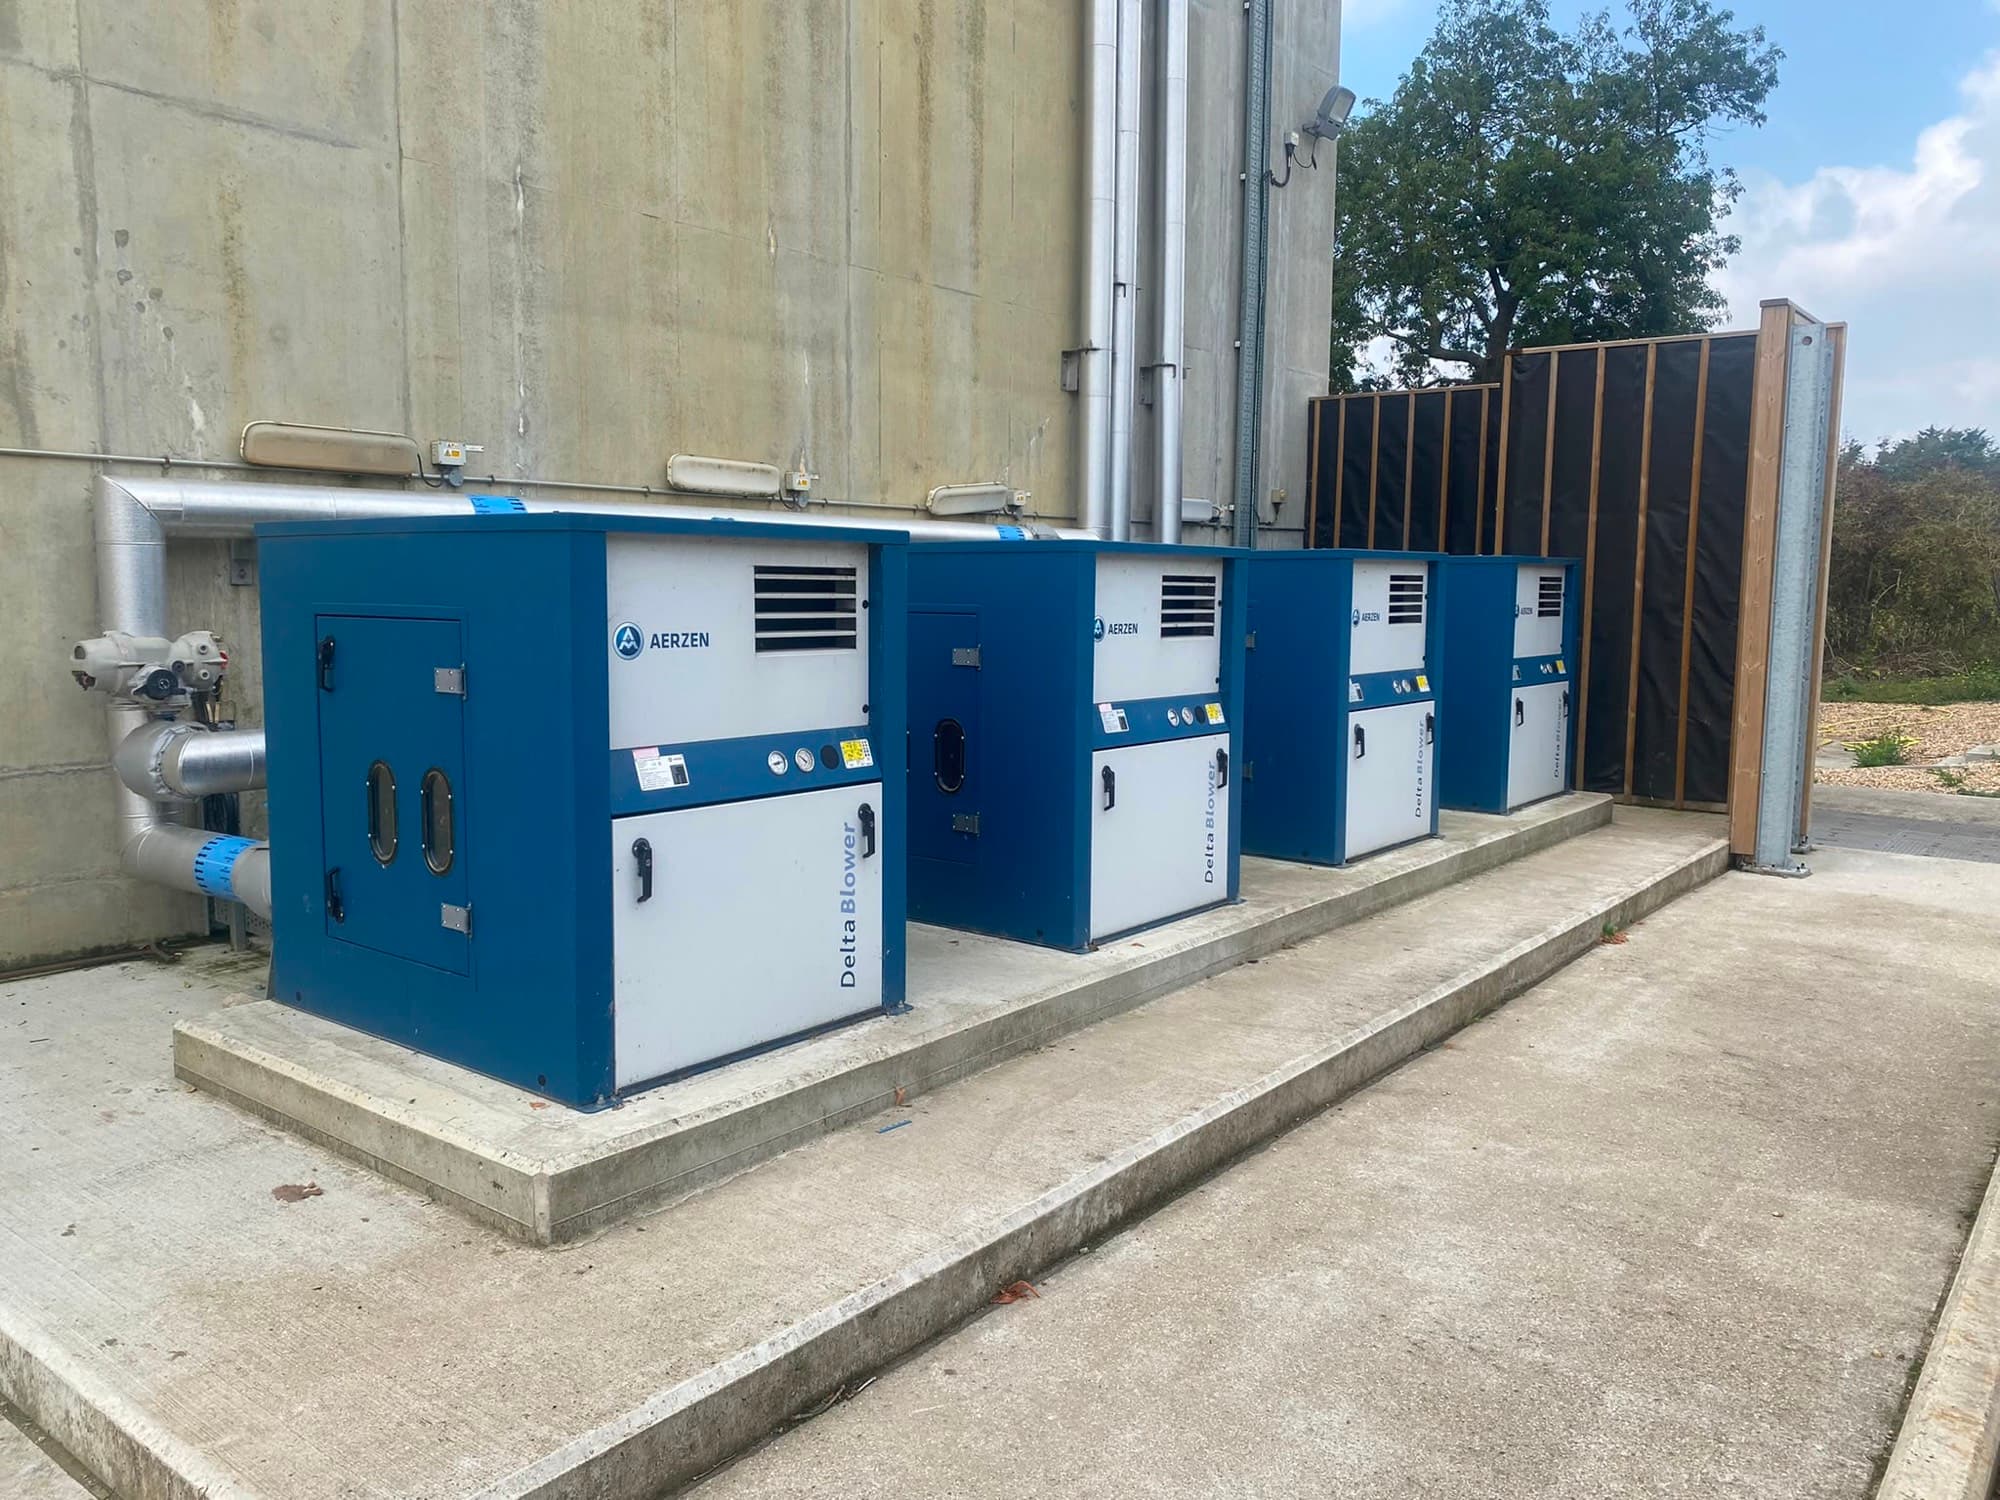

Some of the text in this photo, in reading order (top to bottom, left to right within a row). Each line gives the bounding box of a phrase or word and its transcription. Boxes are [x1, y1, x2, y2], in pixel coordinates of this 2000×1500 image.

[649, 632, 710, 649] AERZEN
[1107, 623, 1139, 635] AERZEN
[1415, 720, 1424, 818] Delta Blower
[1204, 760, 1216, 883] Delta Blower
[840, 822, 856, 988] Delta Blower
